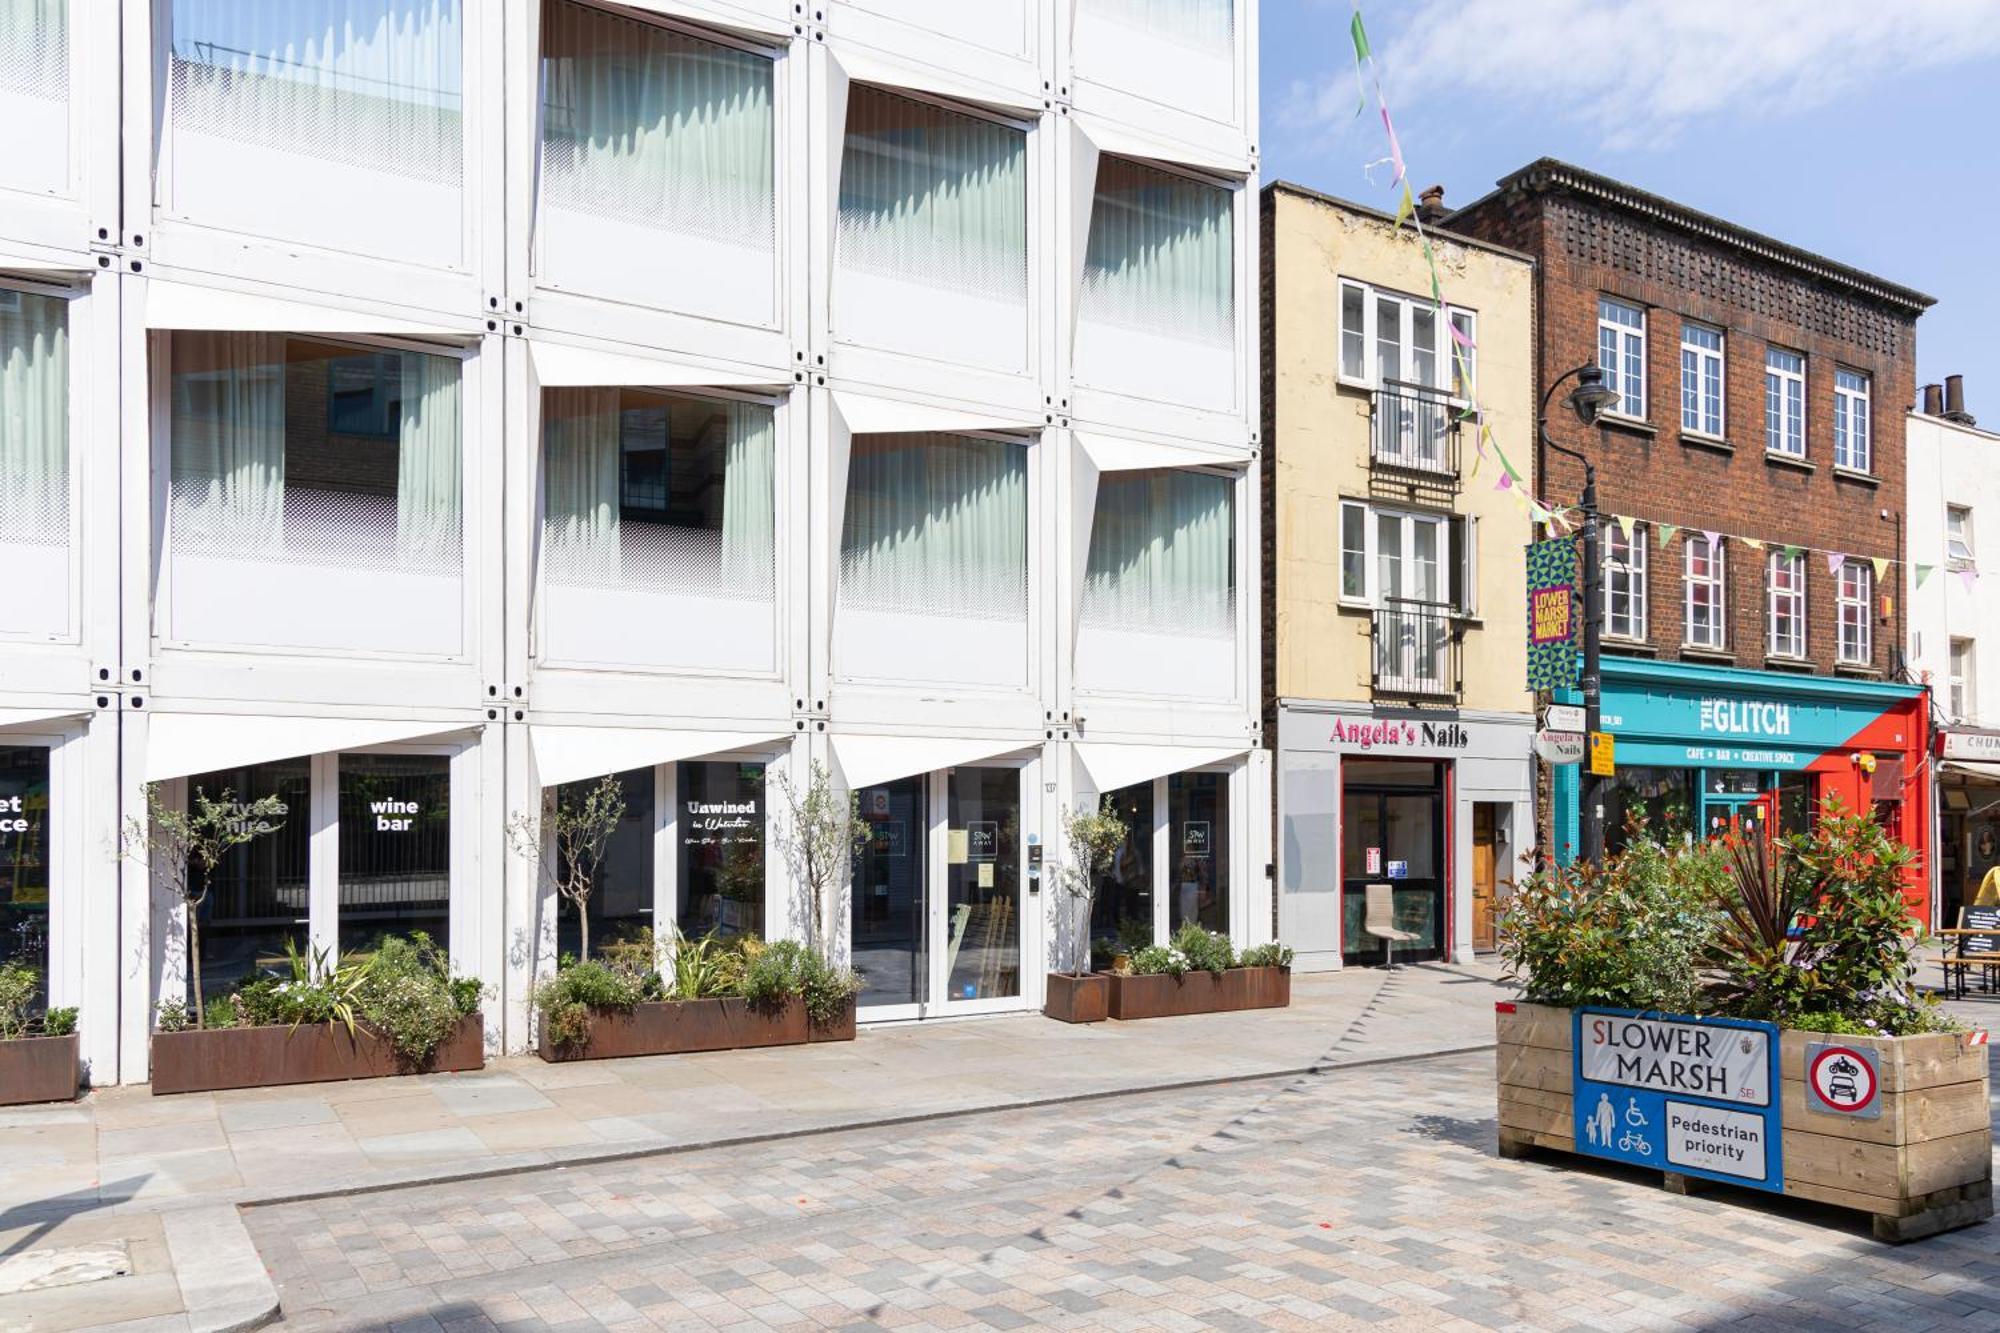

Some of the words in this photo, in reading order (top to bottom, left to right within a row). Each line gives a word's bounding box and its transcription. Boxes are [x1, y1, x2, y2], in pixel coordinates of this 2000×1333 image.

[1536, 591, 1568, 608] LOWER
[1536, 605, 1568, 623] MARSH
[1536, 620, 1567, 639] MARKET
[1701, 696, 1712, 731] THE
[1713, 698, 1790, 735] GLITCH
[1330, 714, 1415, 749] Angela's
[1421, 722, 1468, 748] Nails
[1557, 743, 1581, 756] Nails
[370, 797, 419, 814] wine
[687, 801, 756, 814] Unwined
[377, 815, 413, 831] bar
[1593, 1020, 1713, 1059] SLOWER
[1616, 1054, 1727, 1094] MARSH
[1672, 1115, 1758, 1142] Pedestrian
[1685, 1139, 1744, 1162] priority
